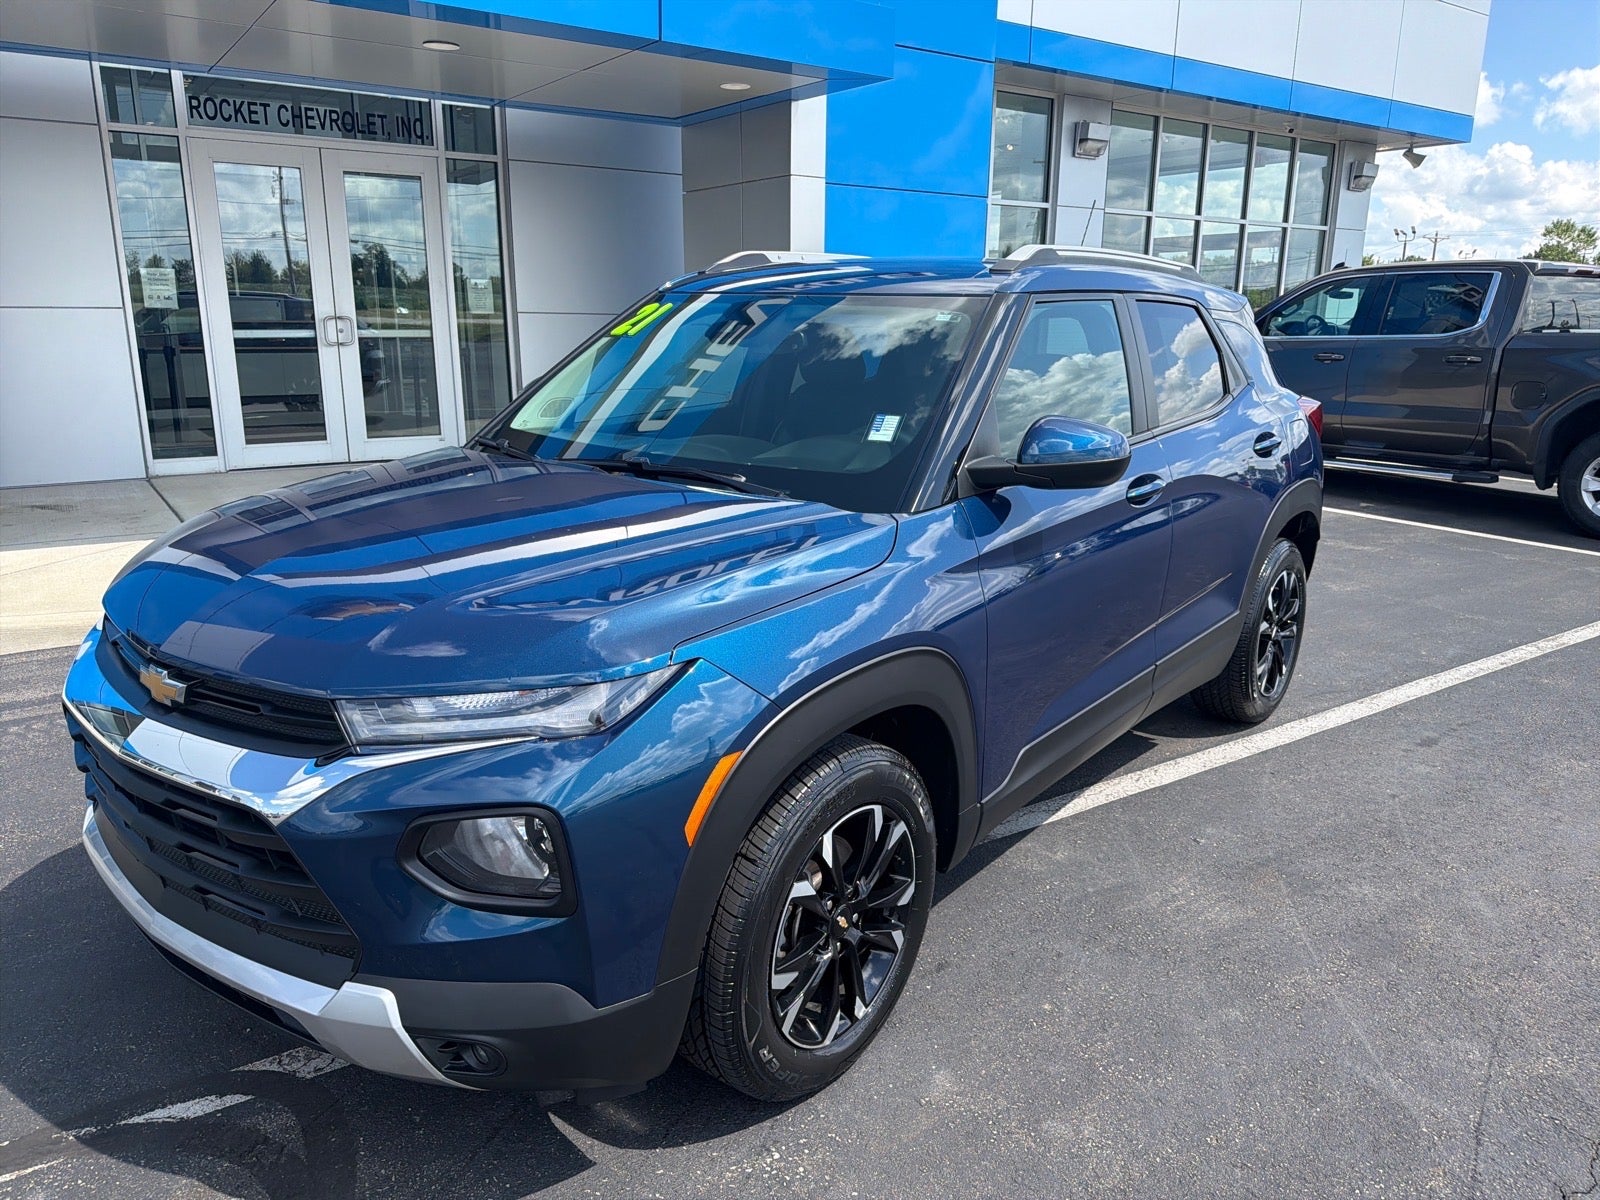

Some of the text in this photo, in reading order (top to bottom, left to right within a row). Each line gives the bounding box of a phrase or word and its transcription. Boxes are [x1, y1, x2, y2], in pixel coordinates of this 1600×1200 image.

[187, 95, 430, 141] ROCKET CHEVROLET, INC.
[610, 302, 673, 336] 21
